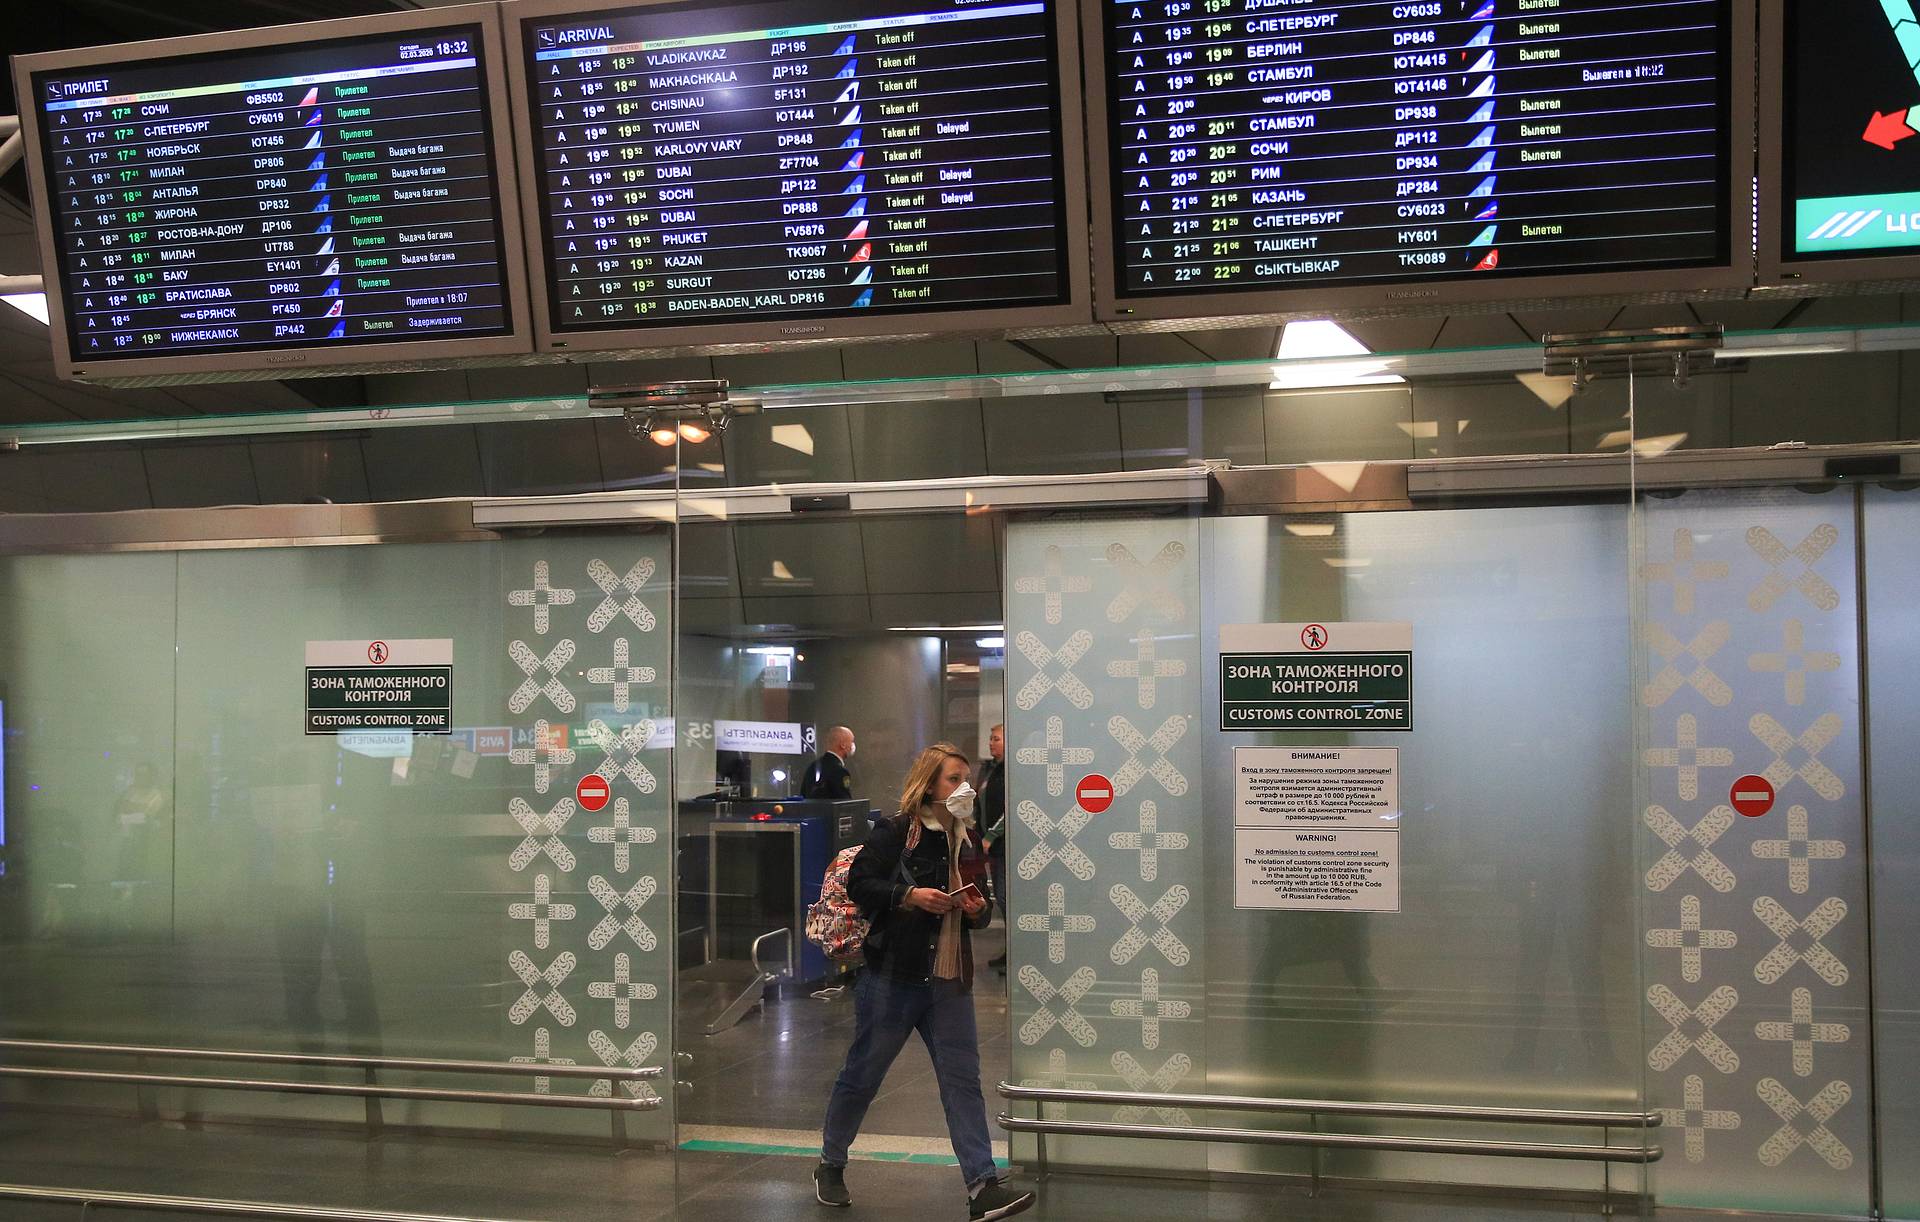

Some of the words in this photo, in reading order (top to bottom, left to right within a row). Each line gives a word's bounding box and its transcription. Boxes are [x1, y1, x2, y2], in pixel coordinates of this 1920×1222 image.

[1246, 13, 1338, 33] С-ПЕТЕРБУРГ
[558, 27, 614, 44] ARRIVAL
[1246, 41, 1303, 58] БЕРЛИН
[1393, 30, 1436, 45] DP846
[1519, 23, 1560, 35] Вылетел
[400, 49, 434, 59] 02.03.2020
[437, 41, 468, 55] 18:32
[646, 48, 727, 65] VLADIKAVKAZ
[770, 41, 806, 56] ДР196
[875, 34, 900, 44] Taken
[902, 31, 914, 42] off
[649, 70, 737, 88] MAKHACHKALA
[772, 64, 808, 79] ДР192
[1247, 64, 1314, 82] СТАМБУЛ
[1393, 52, 1448, 69] ЮТ4415
[64, 80, 109, 95] ПРИЛЕТ
[1285, 88, 1333, 104] КИРОВ
[1394, 78, 1447, 94] ЮТ4146
[141, 103, 169, 116] СОЧИ
[246, 92, 283, 105] ФВ5502
[651, 96, 705, 111] CHISINAU
[774, 87, 806, 100] 5F131
[143, 120, 210, 136] С-ПЕТЕРБУРГ
[652, 120, 700, 133] TYUMEN
[775, 108, 814, 122] ЮТ444
[1249, 114, 1316, 131] СТАМБУЛ
[1395, 105, 1438, 120] DP938
[146, 143, 200, 157] НОЯБРЬСК
[251, 135, 284, 147] ЮТ456
[654, 141, 708, 156] KARLOVY
[710, 139, 742, 151] VARY
[777, 133, 813, 146] DP848
[936, 121, 969, 135] Delayed
[1250, 141, 1290, 156] СОЧИ
[1394, 129, 1438, 147] ДР112
[149, 166, 184, 178] МИЛАН
[254, 156, 284, 168] DP806
[342, 151, 375, 162] Прилетел
[388, 147, 416, 156] Выдача
[417, 144, 443, 154] багажа
[656, 165, 691, 178] DUBAI
[779, 155, 819, 169] ZF7704
[1251, 165, 1282, 180] РИМ
[1396, 155, 1439, 170] DP934
[152, 186, 198, 199] АНТАЛЬЯ
[256, 178, 286, 189] DP840
[658, 188, 693, 201] SOCHI
[781, 179, 816, 194] ДР122
[939, 167, 972, 181] Delayed
[1252, 189, 1306, 204] КАЗАНЬ
[1396, 180, 1439, 196] ДР284
[154, 207, 197, 219] ЖИРОНА
[259, 199, 289, 210] DP832
[660, 209, 695, 223] DUBAI
[782, 201, 818, 214] DP888
[940, 191, 973, 204] Delayed
[1253, 210, 1343, 227] С-ПЕТЕРБУРГ
[157, 223, 243, 240] РОСТОВ-НА-ДОНУ
[262, 220, 292, 233] ДР106
[662, 231, 708, 245] PHUKET
[784, 224, 824, 237] FV5876
[1254, 237, 1317, 251] ТАШКЕНТ
[1398, 229, 1437, 243] HY601
[160, 249, 195, 260] МИЛАН
[264, 241, 294, 252] UT788
[664, 255, 702, 267] KAZAN
[786, 245, 826, 258] TK9067
[163, 270, 188, 281] БАКУ
[266, 260, 300, 271] EY1401
[1254, 260, 1339, 275] СЫКТЫВКАР
[1398, 252, 1446, 265] TK9089
[666, 276, 712, 289] SURGUT
[788, 268, 825, 280] ЮТ296
[165, 287, 232, 301] БРАТИСЛАВА
[269, 282, 300, 294] DP802
[668, 294, 786, 311] BADEN-BADEN_KARL
[790, 292, 824, 304] DP816
[196, 307, 236, 319] БРЯНСК
[272, 303, 300, 314] РГ450
[406, 296, 439, 307] Прилетел
[447, 292, 467, 303] 18:07
[171, 328, 239, 341] НИЖНЕКАМСК
[275, 324, 305, 336] ДР442
[408, 316, 462, 327] Задерживается
[312, 677, 345, 689] ЗОНА
[348, 676, 446, 688] ТАМОЖЕННОГО
[1228, 666, 1272, 679] ЗОНА
[1276, 664, 1403, 678] ТАМОЖЕННОГО
[345, 690, 411, 702] КОНТРОЛЯ
[1272, 680, 1359, 693] КОНТРОЛЯ
[312, 715, 361, 725] CUSTOMS
[364, 715, 413, 725] CONTROL
[416, 715, 445, 725] ZONE
[1229, 708, 1294, 720] CUSTOMS
[1297, 708, 1362, 720] CONTROL
[1365, 708, 1403, 720] ZONE
